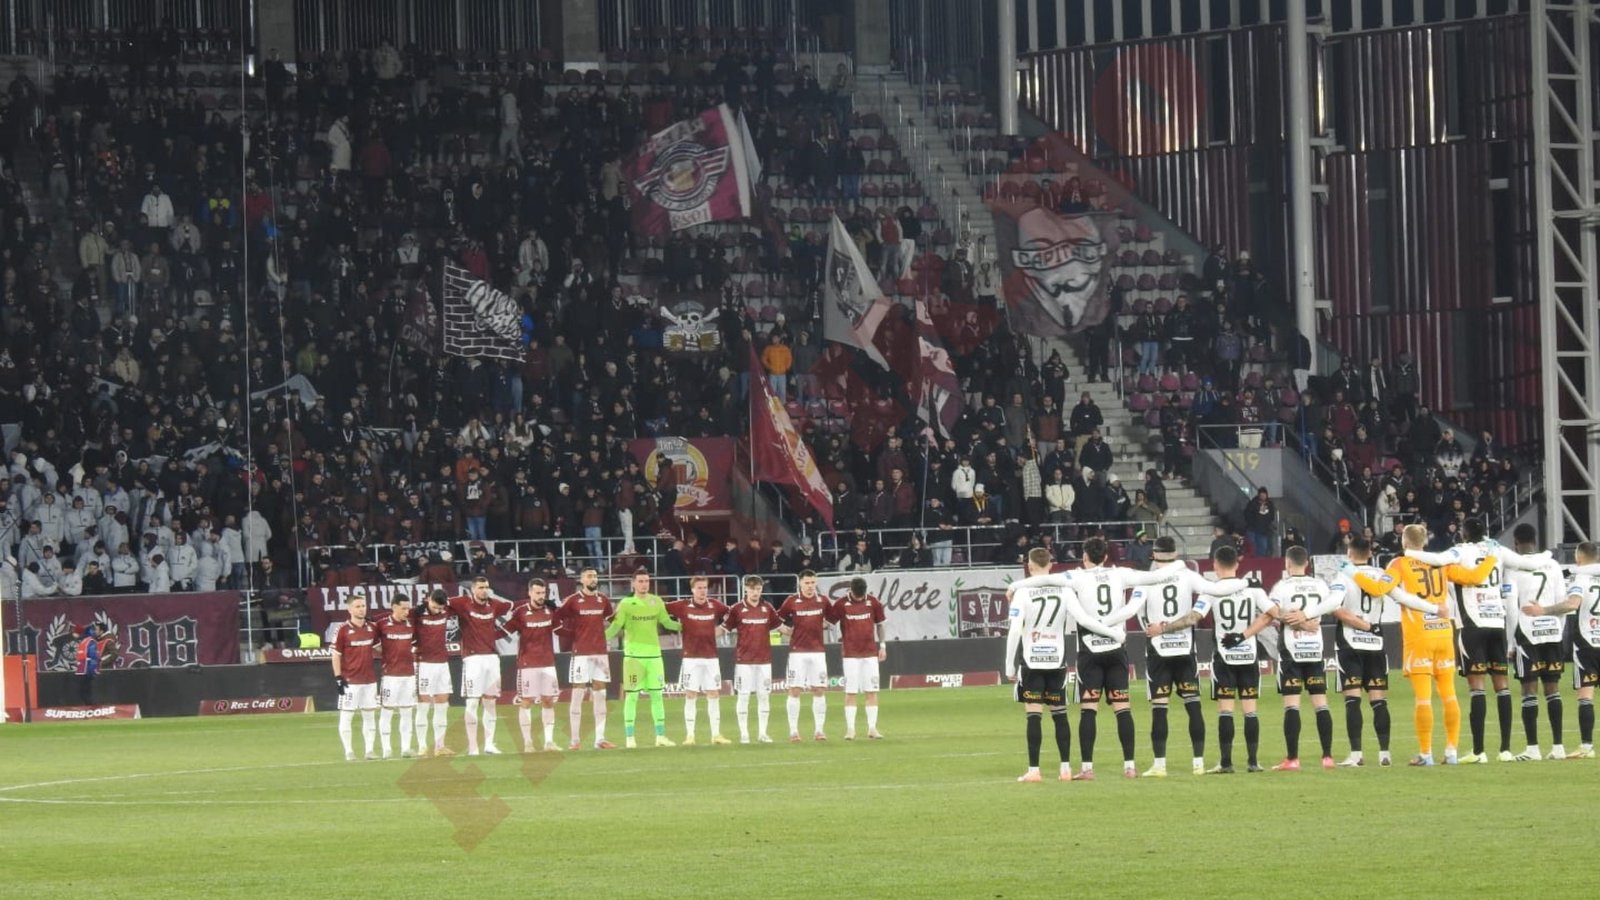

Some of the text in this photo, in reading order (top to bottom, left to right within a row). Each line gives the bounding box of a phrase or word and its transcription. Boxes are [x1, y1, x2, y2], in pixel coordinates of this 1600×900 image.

[1225, 452, 1260, 471] 119
[1411, 568, 1444, 599] 30
[1532, 571, 1547, 601] 7
[1031, 595, 1061, 629] 77
[1096, 583, 1113, 617] 9
[1162, 584, 1178, 618] 8
[1219, 597, 1252, 631] 94
[925, 674, 963, 683] POWER
[45, 705, 116, 719] SUPERSCORE
[252, 698, 276, 709] Café
